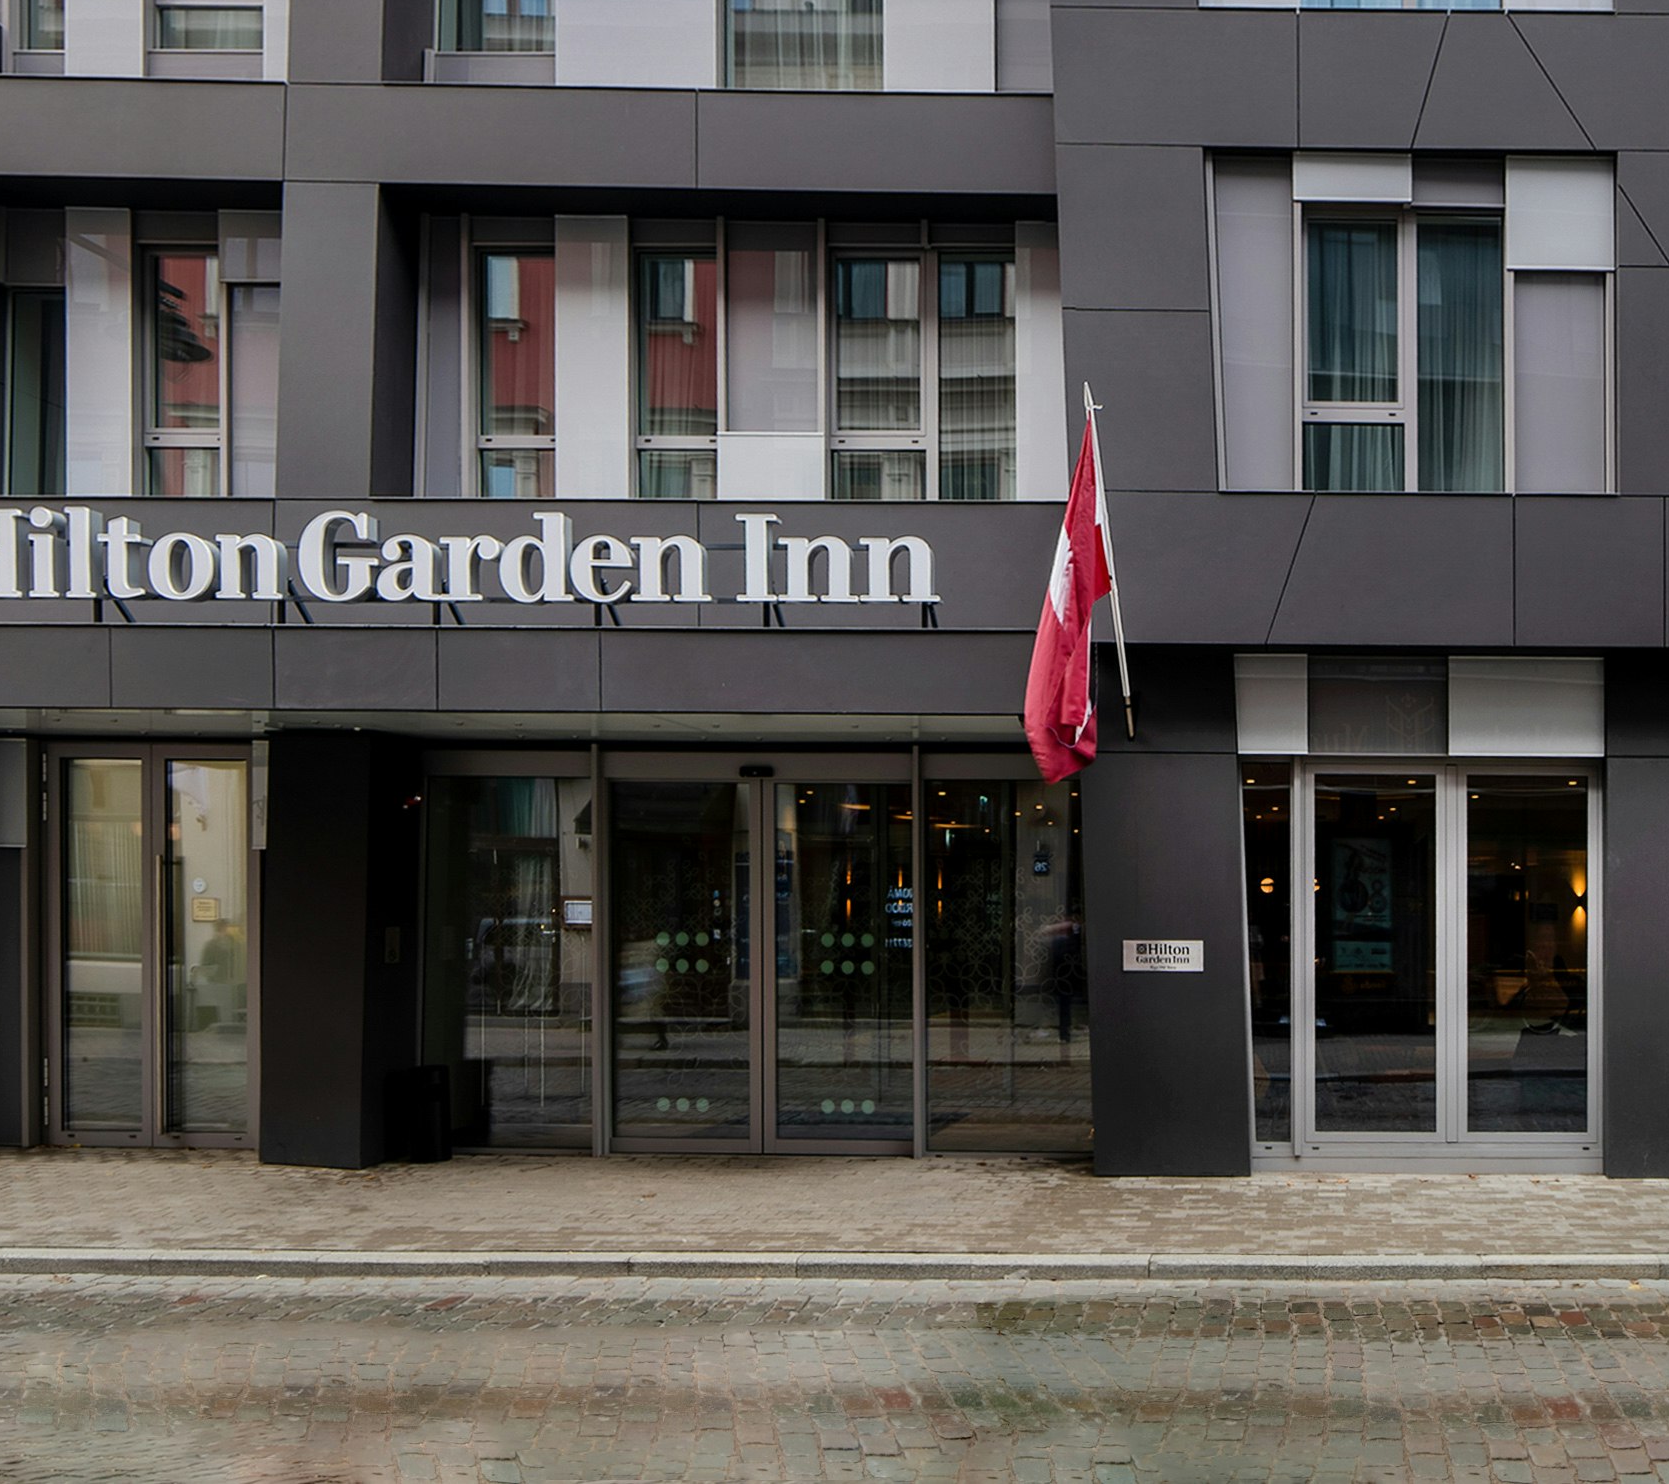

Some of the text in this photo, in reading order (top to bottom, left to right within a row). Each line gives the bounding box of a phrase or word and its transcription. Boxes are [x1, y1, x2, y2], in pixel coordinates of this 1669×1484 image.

[298, 509, 713, 603] Garden
[734, 512, 942, 603] Inn
[1148, 943, 1190, 955] Hilton
[1136, 955, 1190, 964] Garden Inn
